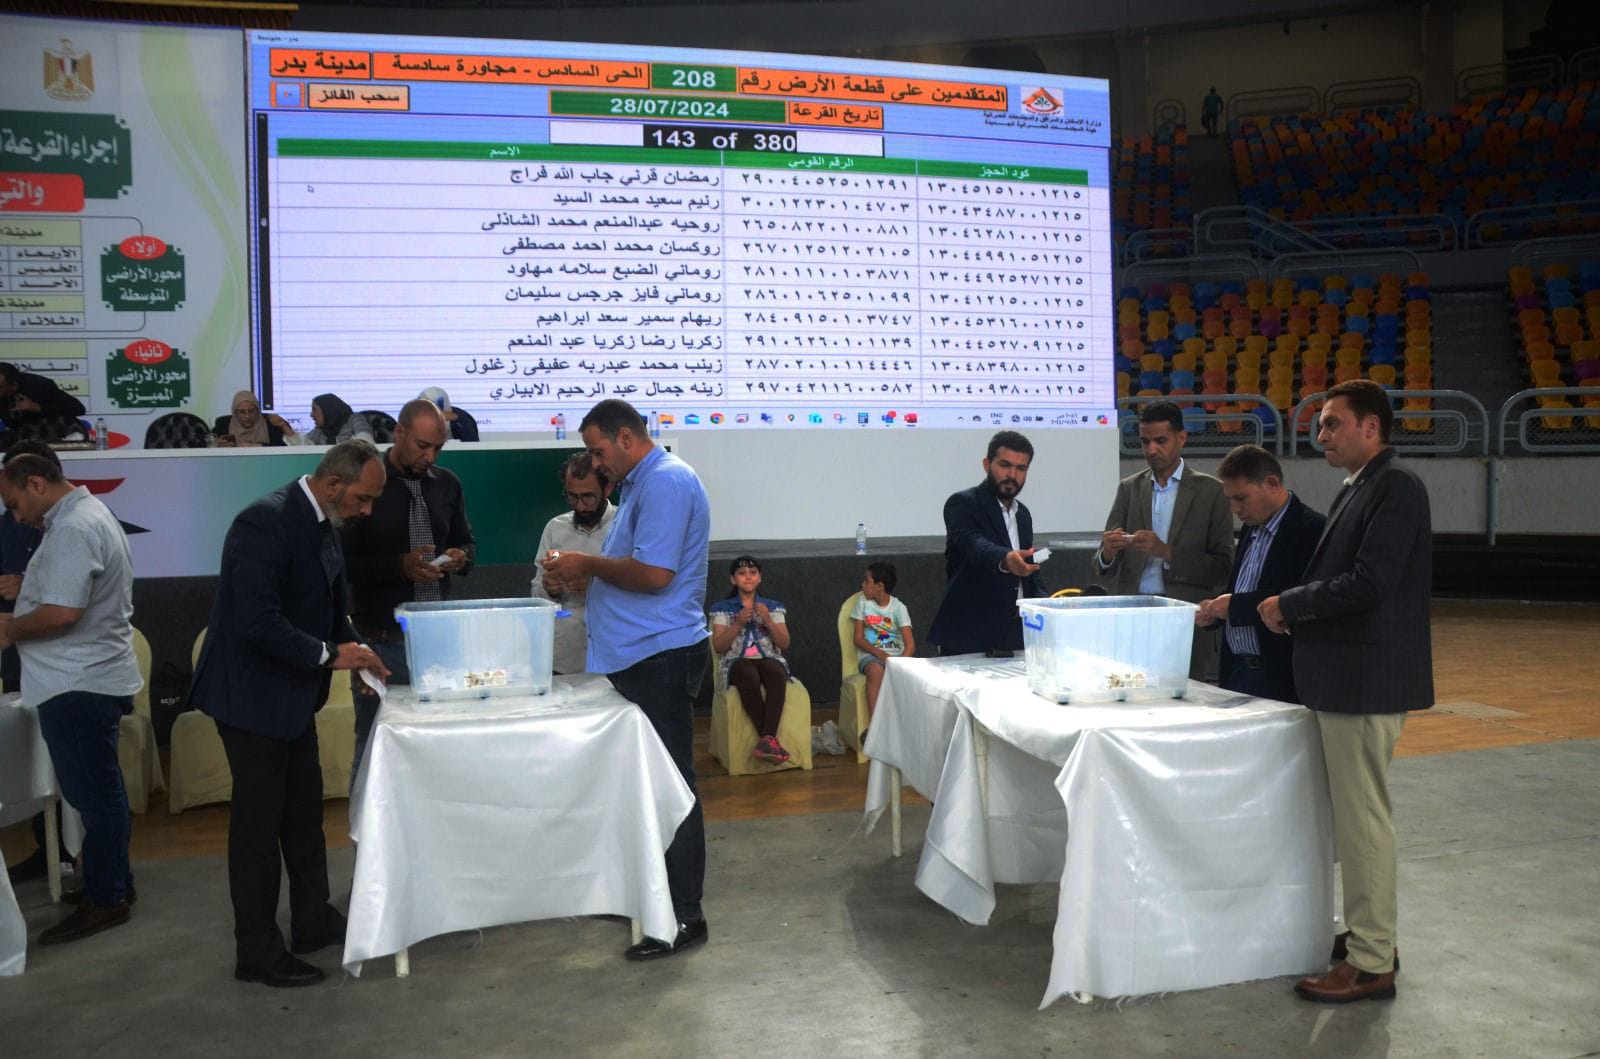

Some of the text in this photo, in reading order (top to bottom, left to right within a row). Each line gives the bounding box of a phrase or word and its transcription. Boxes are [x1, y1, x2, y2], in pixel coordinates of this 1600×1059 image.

[273, 52, 367, 75] مدينة بدر
[392, 54, 450, 71] سادسة
[456, 58, 517, 76] مجاورة
[537, 63, 599, 78] السادس
[671, 69, 717, 88] 208
[740, 71, 771, 92] رقم
[778, 74, 836, 93] الأرض
[842, 75, 885, 94] قطعة
[360, 92, 400, 104] سحب
[931, 87, 1005, 104] المتقدمين
[610, 97, 730, 118] 28/07/2024
[793, 102, 880, 124] تاريخ القرعة
[1, 127, 70, 162] القرعة
[652, 129, 796, 151] 143 of 380
[71, 133, 119, 164] إجراء
[489, 145, 520, 159] الاسم
[828, 156, 855, 169] الرقم
[510, 165, 719, 186] رمضان قرني جاب الله فراج
[979, 165, 1030, 179] كود الحجز
[742, 173, 907, 190] ٢٩٠٠٤٠٥٢٥٠١٢٩١
[928, 182, 1080, 199] ١٣٠٤٥١٥١٠٠١٢١٥
[554, 191, 719, 210] رنيم سعيد محمد السيد
[741, 197, 909, 212] ٣٠٠١٢٢٣٠١٠٤٧٠٣
[928, 205, 1081, 221] ١٣٠٤٣٤٨٧٠٠١٢١٥
[548, 217, 587, 226] محمد
[671, 218, 720, 233] روحيه
[743, 220, 907, 235] ٢٦٥٠٨٢٢٠١٠٠٨٨١
[929, 227, 1082, 242] ١٣٠٤٦٢٨١٠٠١٢١٥
[503, 237, 720, 256] روكسان محمد احمد مصطفى
[743, 243, 910, 256] ٢٦٧٠١٢٥١٢٠٢١٠٥
[930, 249, 1082, 264] ١٣٠٤٤٩٩١٠٥١٢١٥
[152, 269, 182, 283] محور
[559, 263, 606, 274] سلامه
[613, 263, 658, 280] الضبع
[665, 264, 720, 281] روماني
[744, 266, 908, 280] ٢٨١٠١١١٠١٠٣٨٧١
[930, 271, 1083, 285] ١٣٠٤٤٩٢٥٢٧١٢١٥
[120, 287, 170, 304] المتوسطة
[505, 285, 721, 305] روماني فايز جرجس سليمان
[744, 289, 910, 302] ٢٨٦٠١٠٦٢٥٠١٠٩٩
[930, 294, 1083, 307] ١٣٠٤١٢١٥٠٠١٢١٥
[537, 311, 721, 328] ريهام سمير سعد ابراهيم
[745, 313, 911, 325] ٢٨٤٠٩١٥٠١٠٣٧٤٧
[931, 317, 1084, 329] ١٣٠٤٥٣١٦٠٠١٢١٥
[508, 334, 722, 351] زكريا رضا زكريا عبد المنعم
[745, 335, 911, 348] ٢٩١٠٦٢٦٠١٠١١٣٩
[931, 339, 1084, 351] ١٣٠٤٤٥٢٧٠٩١٢١٥
[465, 358, 517, 374] زغلول
[578, 360, 631, 373] عبدربه
[640, 361, 678, 369] محمد
[685, 359, 722, 373] زينب
[745, 359, 911, 370] ٢٨٧٠٢٠١٠١١٤٤٤٦
[932, 362, 1085, 373] ١٣٠٤٨٣٩٨٠٠١٢١٥
[156, 370, 187, 384] محور
[490, 381, 723, 400] زينه جمال عبد الرحيم الابياري
[746, 382, 912, 393] ٢٩٧٠٤٢١١٦٠٠٥٨٢
[932, 384, 1085, 395] ١٣٠٤٠٩٣٨٠٠١٢١٥
